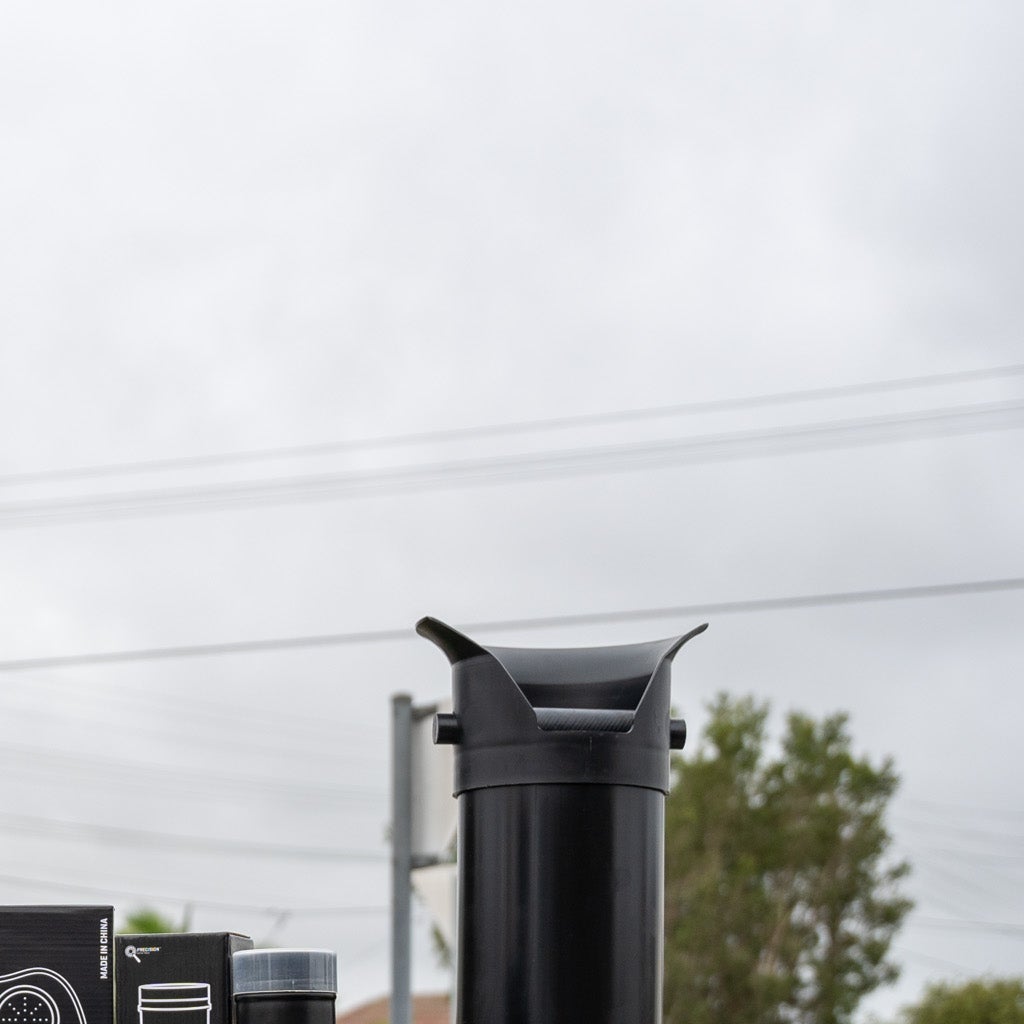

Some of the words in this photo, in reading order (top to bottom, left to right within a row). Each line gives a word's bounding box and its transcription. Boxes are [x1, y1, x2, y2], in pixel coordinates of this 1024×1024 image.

[100, 918, 108, 945] CHINA
[100, 946, 108, 955] IN
[100, 956, 108, 979] MADE
